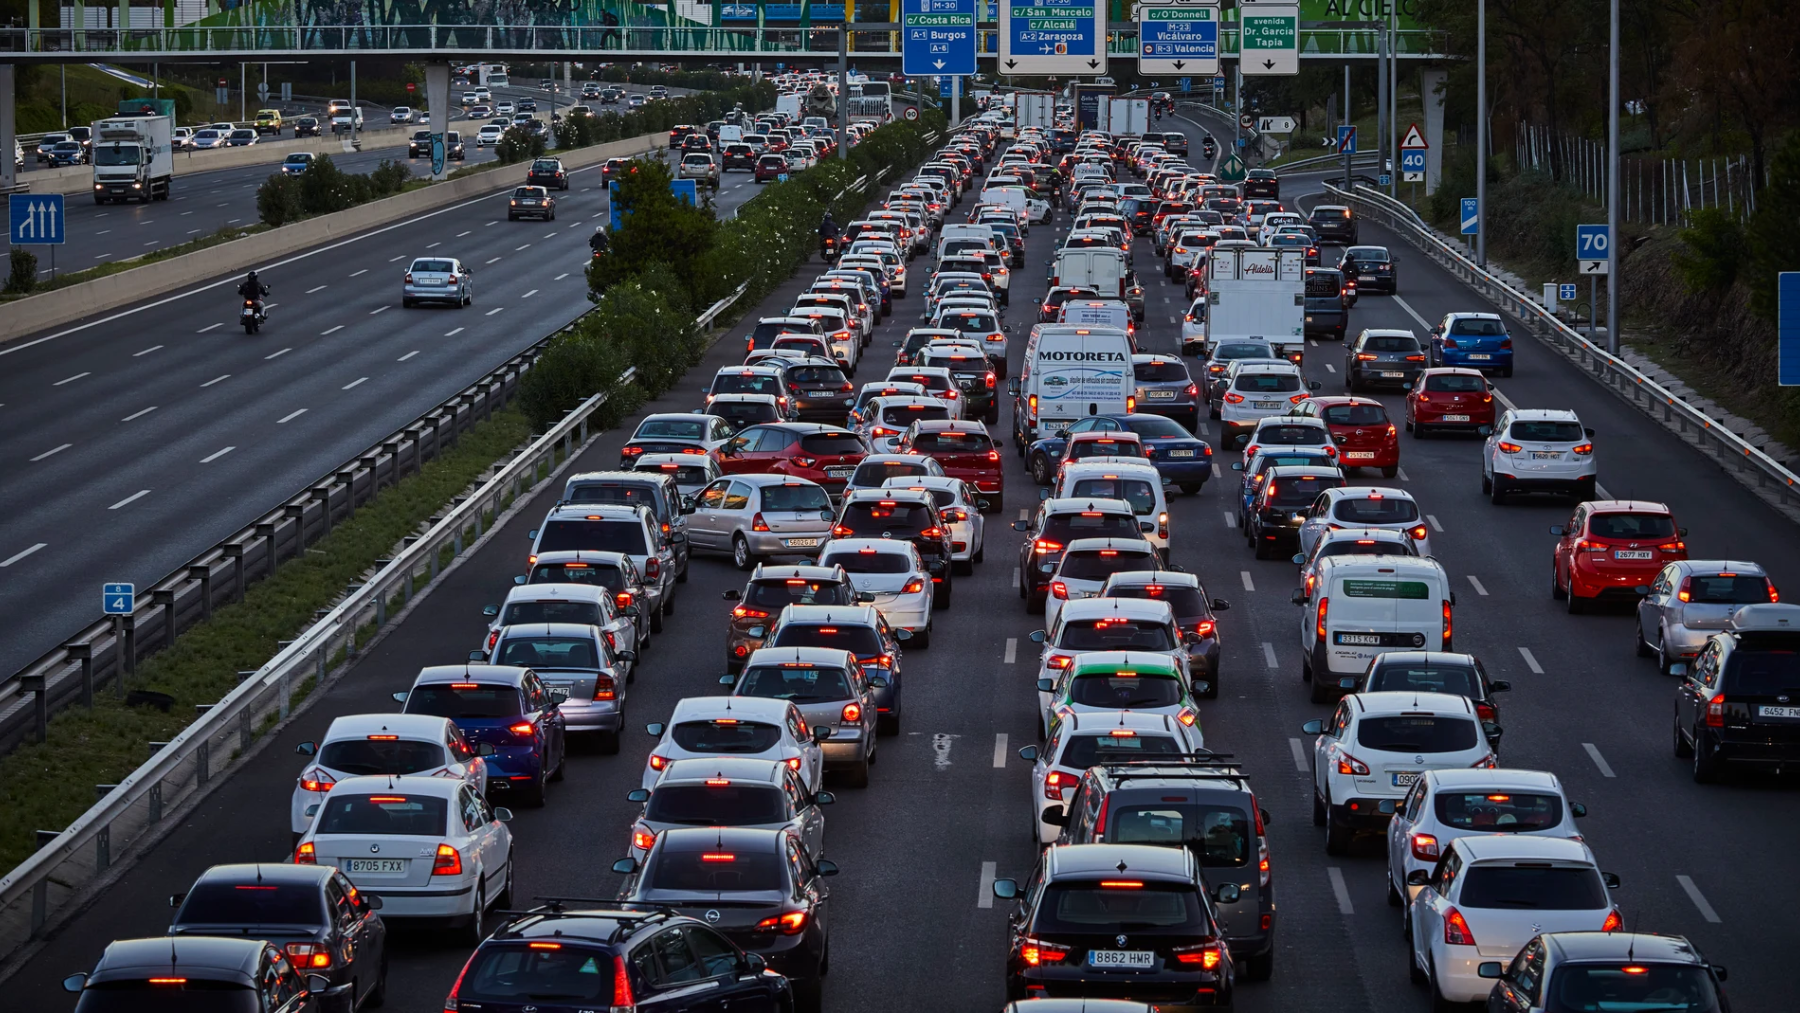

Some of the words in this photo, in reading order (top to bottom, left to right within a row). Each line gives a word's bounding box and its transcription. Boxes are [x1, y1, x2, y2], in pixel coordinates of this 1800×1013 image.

[1051, 8, 1092, 16] Marcelo
[950, 16, 971, 24] Rica
[931, 31, 966, 41] Burgos
[1157, 31, 1202, 40] Vicálvaro
[1244, 27, 1259, 35] Dr.
[1038, 32, 1083, 42] Zaragoza
[1255, 38, 1283, 48] Tapia
[1174, 44, 1215, 53] Valencia
[1403, 154, 1424, 167] 40
[1581, 233, 1608, 251] 70
[1039, 351, 1126, 361] MOTORETA
[116, 585, 122, 593] 8
[112, 597, 125, 610] 4
[1764, 707, 1784, 716] 6452
[1399, 775, 1418, 784] 090
[353, 861, 380, 871] 8705
[382, 861, 402, 871] FXX
[1096, 952, 1126, 963] 8862
[1129, 953, 1151, 964] HMR
